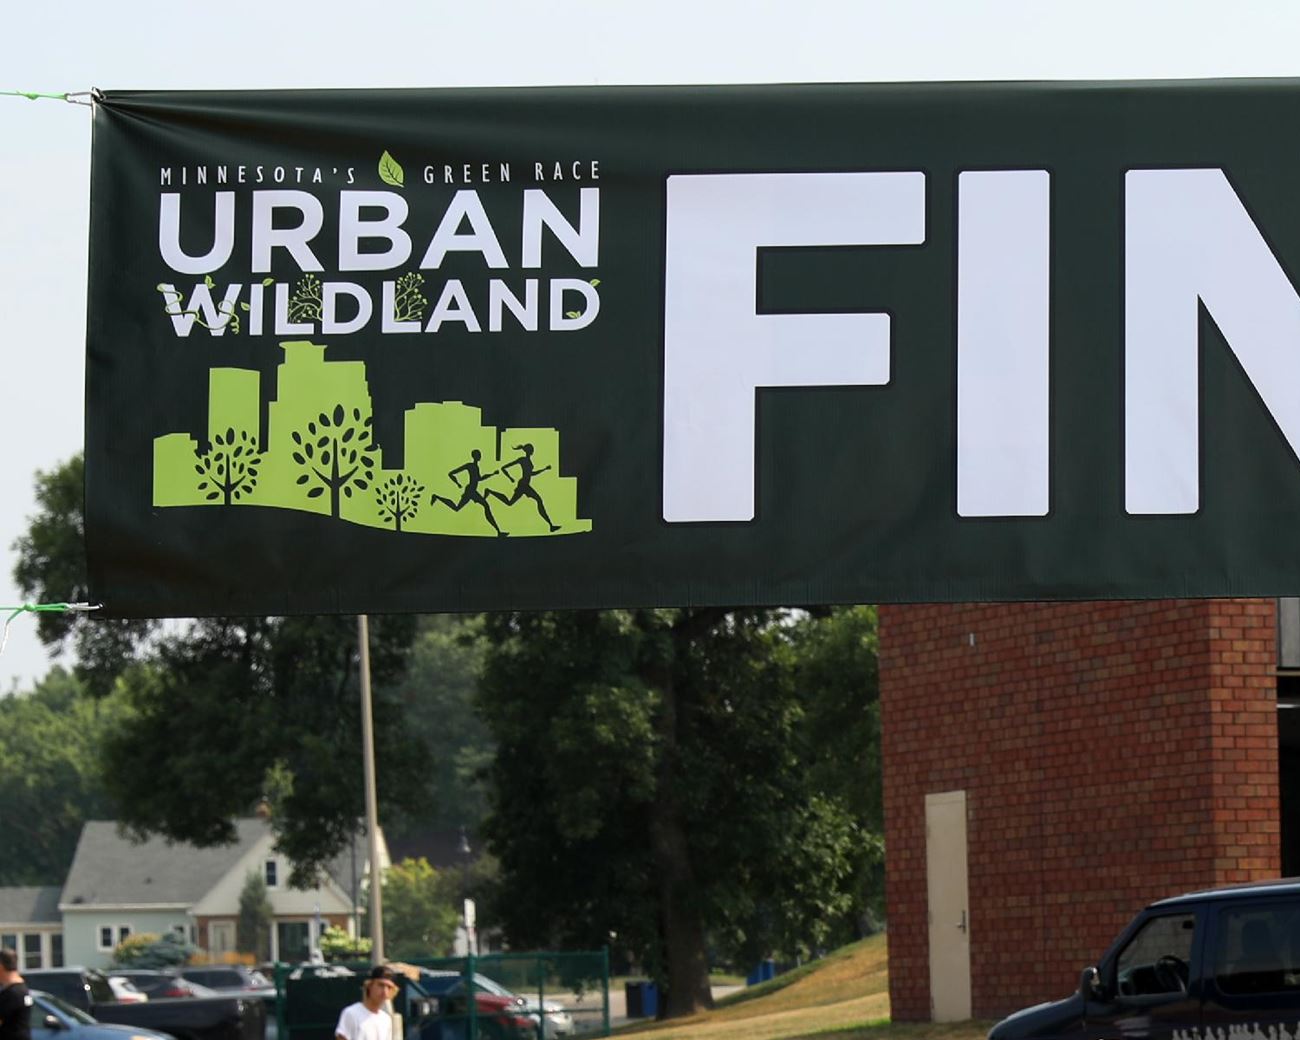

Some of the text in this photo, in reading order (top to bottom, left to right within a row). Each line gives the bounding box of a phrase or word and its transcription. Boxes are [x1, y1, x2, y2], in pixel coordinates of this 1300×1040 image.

[160, 160, 600, 186] MINNESOTA'S GREEN RACE
[158, 187, 600, 275] URBAN
[160, 277, 600, 338] WILDLAND
